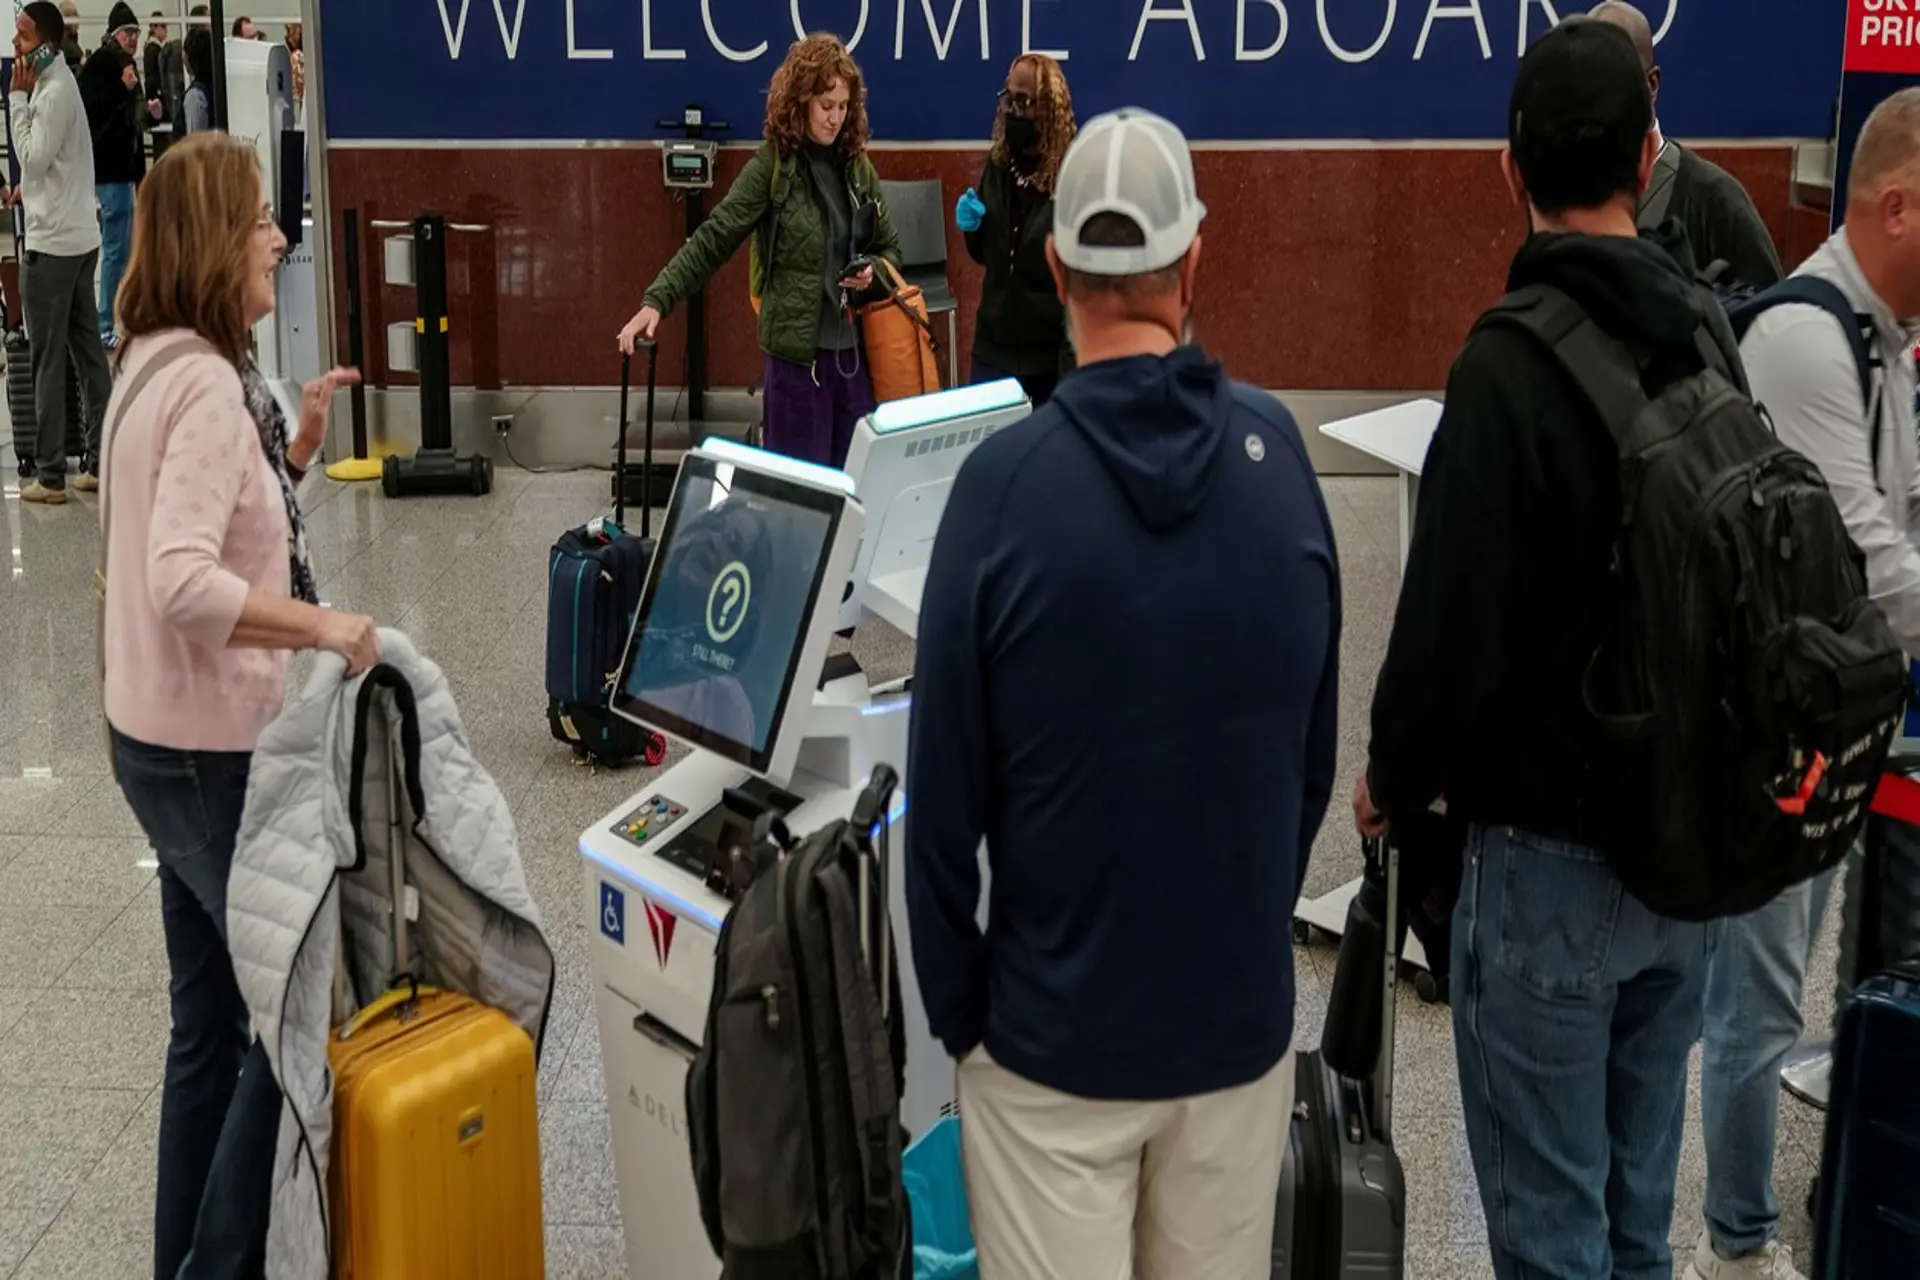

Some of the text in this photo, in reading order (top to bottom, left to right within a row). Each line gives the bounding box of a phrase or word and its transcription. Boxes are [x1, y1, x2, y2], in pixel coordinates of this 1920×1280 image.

[1128, 0, 1679, 62] ABOA
[1860, 15, 1920, 46] PRI
[645, 1093, 686, 1135] DEL
